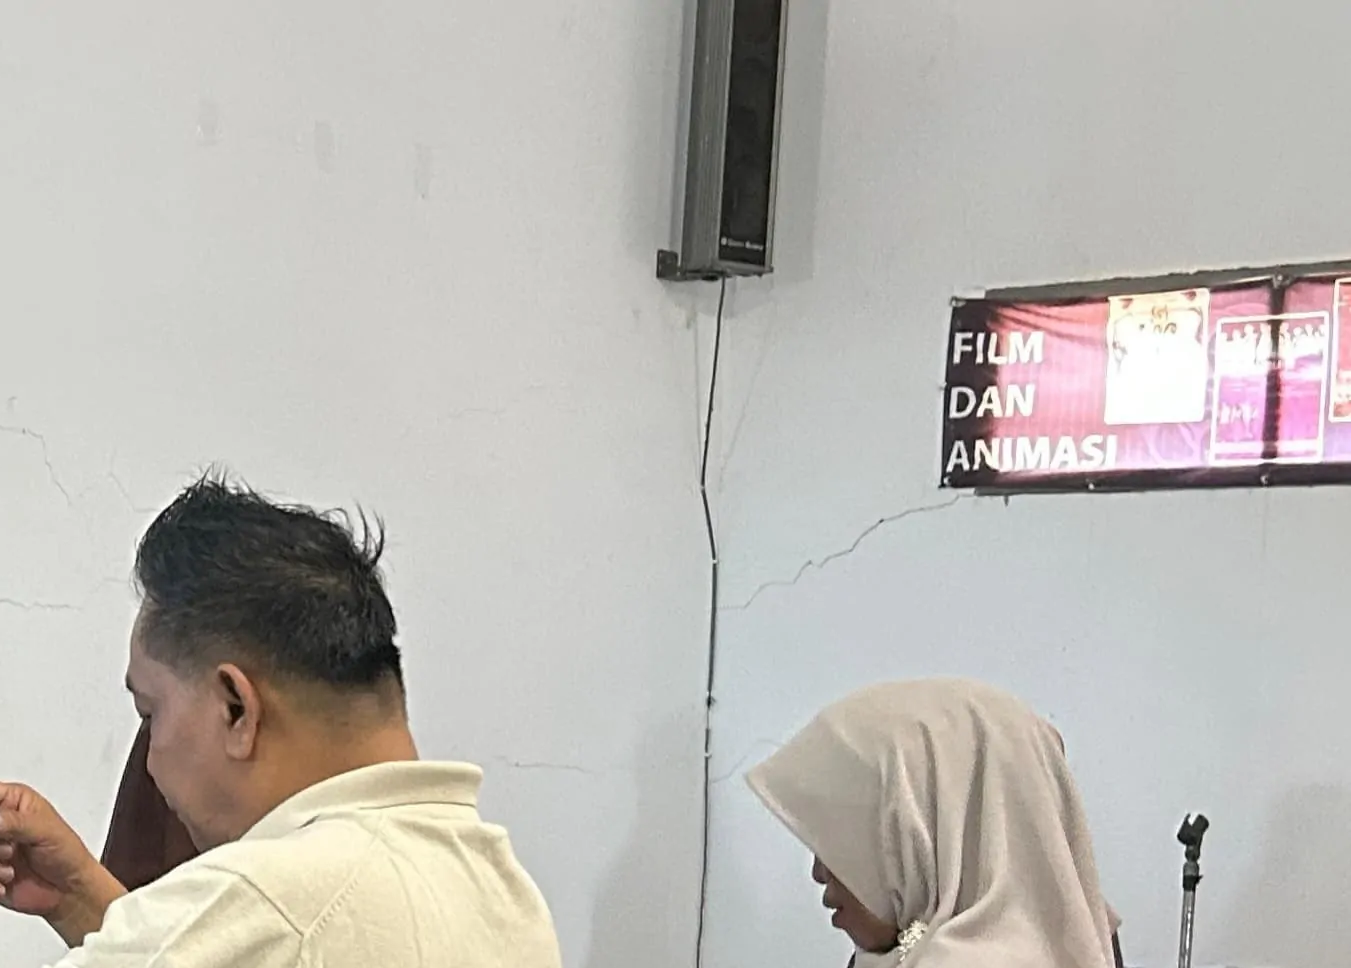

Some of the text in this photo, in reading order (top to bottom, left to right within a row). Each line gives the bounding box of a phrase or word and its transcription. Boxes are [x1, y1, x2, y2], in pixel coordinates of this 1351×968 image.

[953, 332, 1044, 364] FILM
[949, 384, 1035, 418] DAN
[946, 435, 1118, 472] ANIMASI
